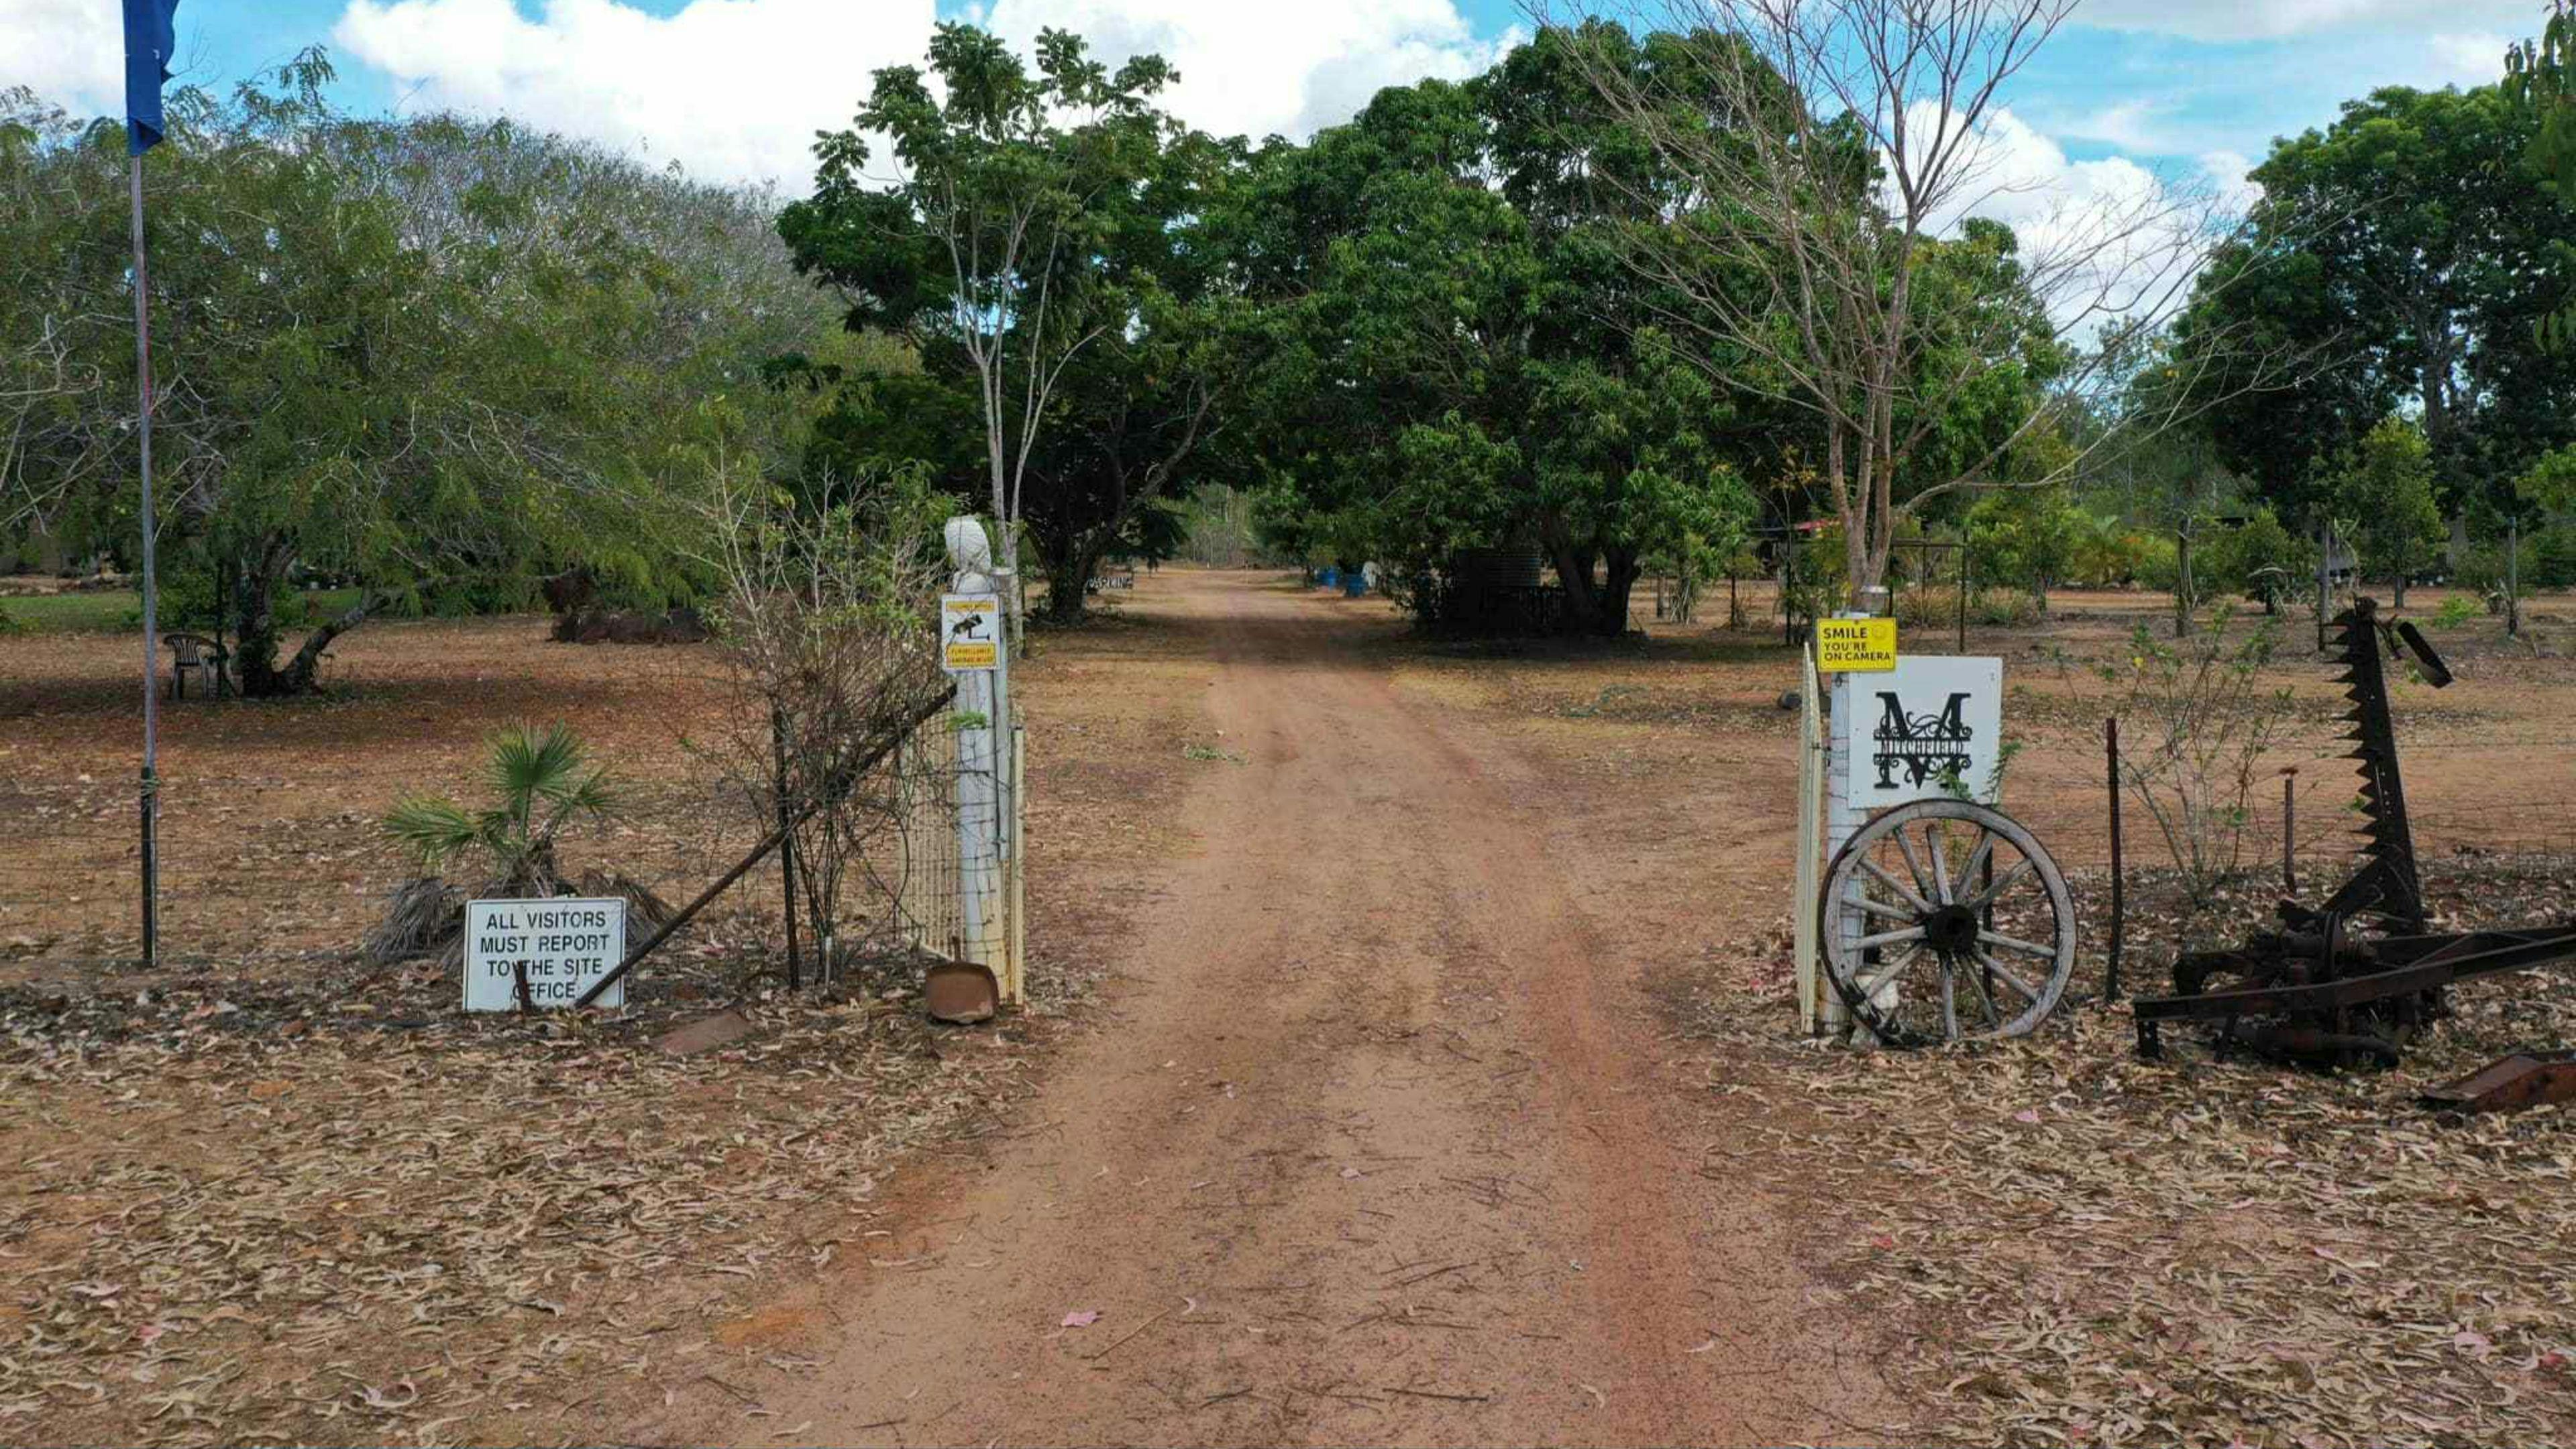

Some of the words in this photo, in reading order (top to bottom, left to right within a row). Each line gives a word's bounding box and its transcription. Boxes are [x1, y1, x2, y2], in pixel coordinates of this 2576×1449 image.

[1823, 627, 1868, 639] SMILE
[1824, 642, 1867, 651] YOU'RE
[1825, 652, 1842, 661] ON
[1845, 652, 1891, 661] CAMERA
[486, 913, 519, 930] ALL
[527, 911, 606, 929] VISITORS
[480, 936, 529, 953] MUST
[539, 934, 610, 952] REPORT
[486, 960, 511, 976] TO
[522, 959, 554, 975] THE
[564, 958, 603, 975] SITE
